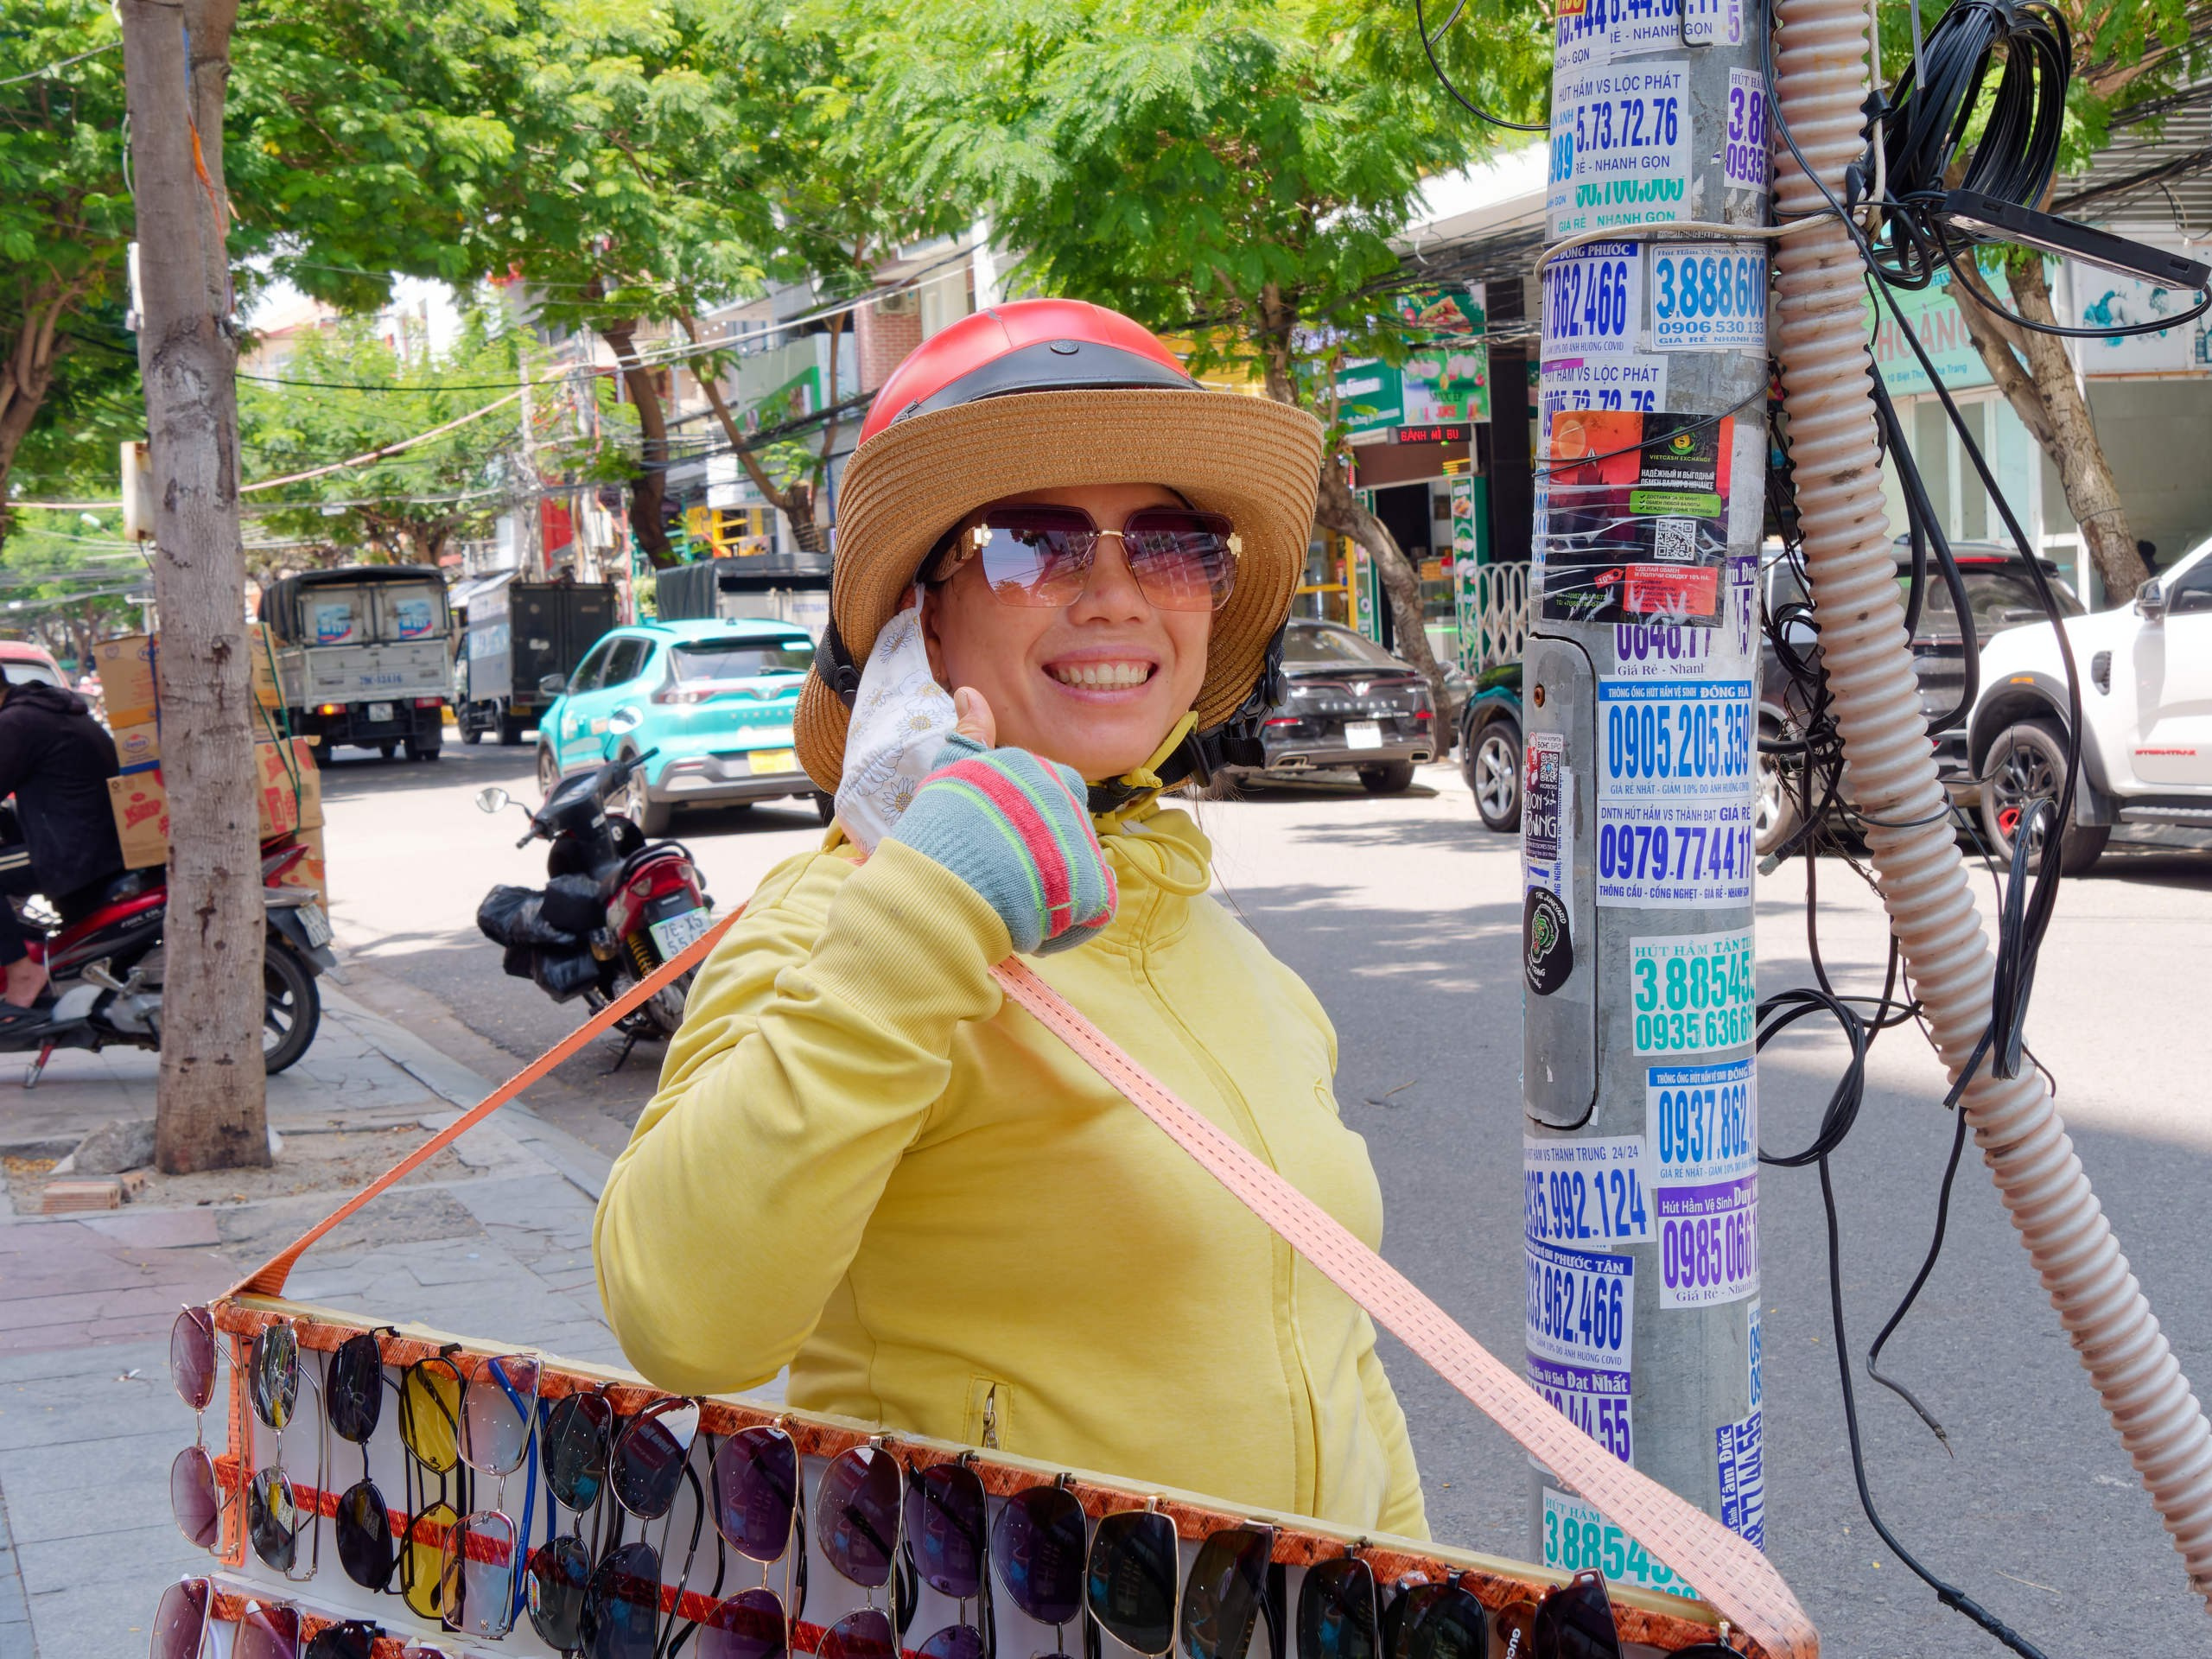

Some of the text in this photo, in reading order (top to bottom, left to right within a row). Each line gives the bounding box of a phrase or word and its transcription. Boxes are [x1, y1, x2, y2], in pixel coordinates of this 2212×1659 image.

[1633, 22, 1713, 40] NHANH GỌN
[1573, 48, 1590, 64] GỌN
[1596, 79, 1611, 94] VS
[1615, 74, 1640, 95] LỘC
[1645, 70, 1681, 90] PHÁT
[1595, 156, 1670, 172] NHANH GỌN
[1558, 218, 1571, 232] GIÁ
[1574, 214, 1586, 229] RẺ
[1597, 213, 1641, 226] NHANH
[1588, 241, 1630, 257] PHƯỚC
[1656, 257, 1764, 320] 3.888.600
[1658, 321, 1764, 334] 0906.530.133
[1659, 335, 1683, 344] GIÁ
[1578, 364, 1659, 385] VS LỘC PHÁT
[1947, 364, 1967, 376] Trang
[1641, 469, 1677, 479] НАДЁЖНЫЙ
[1682, 471, 1714, 480] ВЫГОДНЫЙ
[1618, 663, 1658, 676] Giá Rẻ
[1608, 687, 1630, 698] THÔNG
[1630, 685, 1645, 698] ỐNG
[1700, 685, 1736, 698] ĐÔNG
[1738, 684, 1749, 697] HÀ
[1609, 703, 1750, 779] 0905.205.359
[1611, 782, 1624, 794] GIÁ
[1625, 782, 1635, 794] RẺ
[1637, 780, 1656, 794] NHẤT
[1601, 807, 1623, 819] DNTN
[1625, 805, 1641, 820] HÚT
[1663, 810, 1673, 821] VS
[1676, 804, 1700, 821] THÀNH
[1704, 810, 1716, 823] ĐẠT
[1719, 802, 1739, 820] GIÁ
[1742, 801, 1751, 820] RẺ
[1600, 824, 1751, 880] 0979.77.44.11
[1599, 884, 1624, 897] THÔNG
[1649, 884, 1671, 898] CỐNG
[1674, 888, 1698, 901] NGHẸT
[1704, 887, 1714, 899] GIÁ
[1543, 893, 1567, 925] JUNKYARD
[1635, 944, 1669, 957] HÚT
[1714, 938, 1739, 953] TÂN
[1728, 1066, 1748, 1081] ĐÔNG
[1551, 1145, 1573, 1161] THÀNH
[1576, 1146, 1606, 1160] TRUNG
[1612, 1145, 1638, 1159] 24/24
[1660, 1166, 1673, 1179] GIÁ
[1662, 1200, 1679, 1214] Hút
[1681, 1198, 1703, 1214] Hầm
[1705, 1198, 1715, 1214] Vệ
[1717, 1196, 1732, 1209] Sinh
[1734, 1186, 1751, 1207] Duy
[1554, 1252, 1592, 1270] PHƯỚC
[1595, 1259, 1624, 1274] TÂN
[1676, 1289, 1699, 1301] Giá
[1728, 1282, 1752, 1296] Nhanh
[1601, 1355, 1622, 1366] COVID
[1567, 1370, 1588, 1392] Đạt
[1592, 1373, 1628, 1392] Nhất
[1719, 1427, 1733, 1463] Đức
[1721, 1466, 1736, 1506] Tâm
[1546, 1497, 1566, 1514] HÚT
